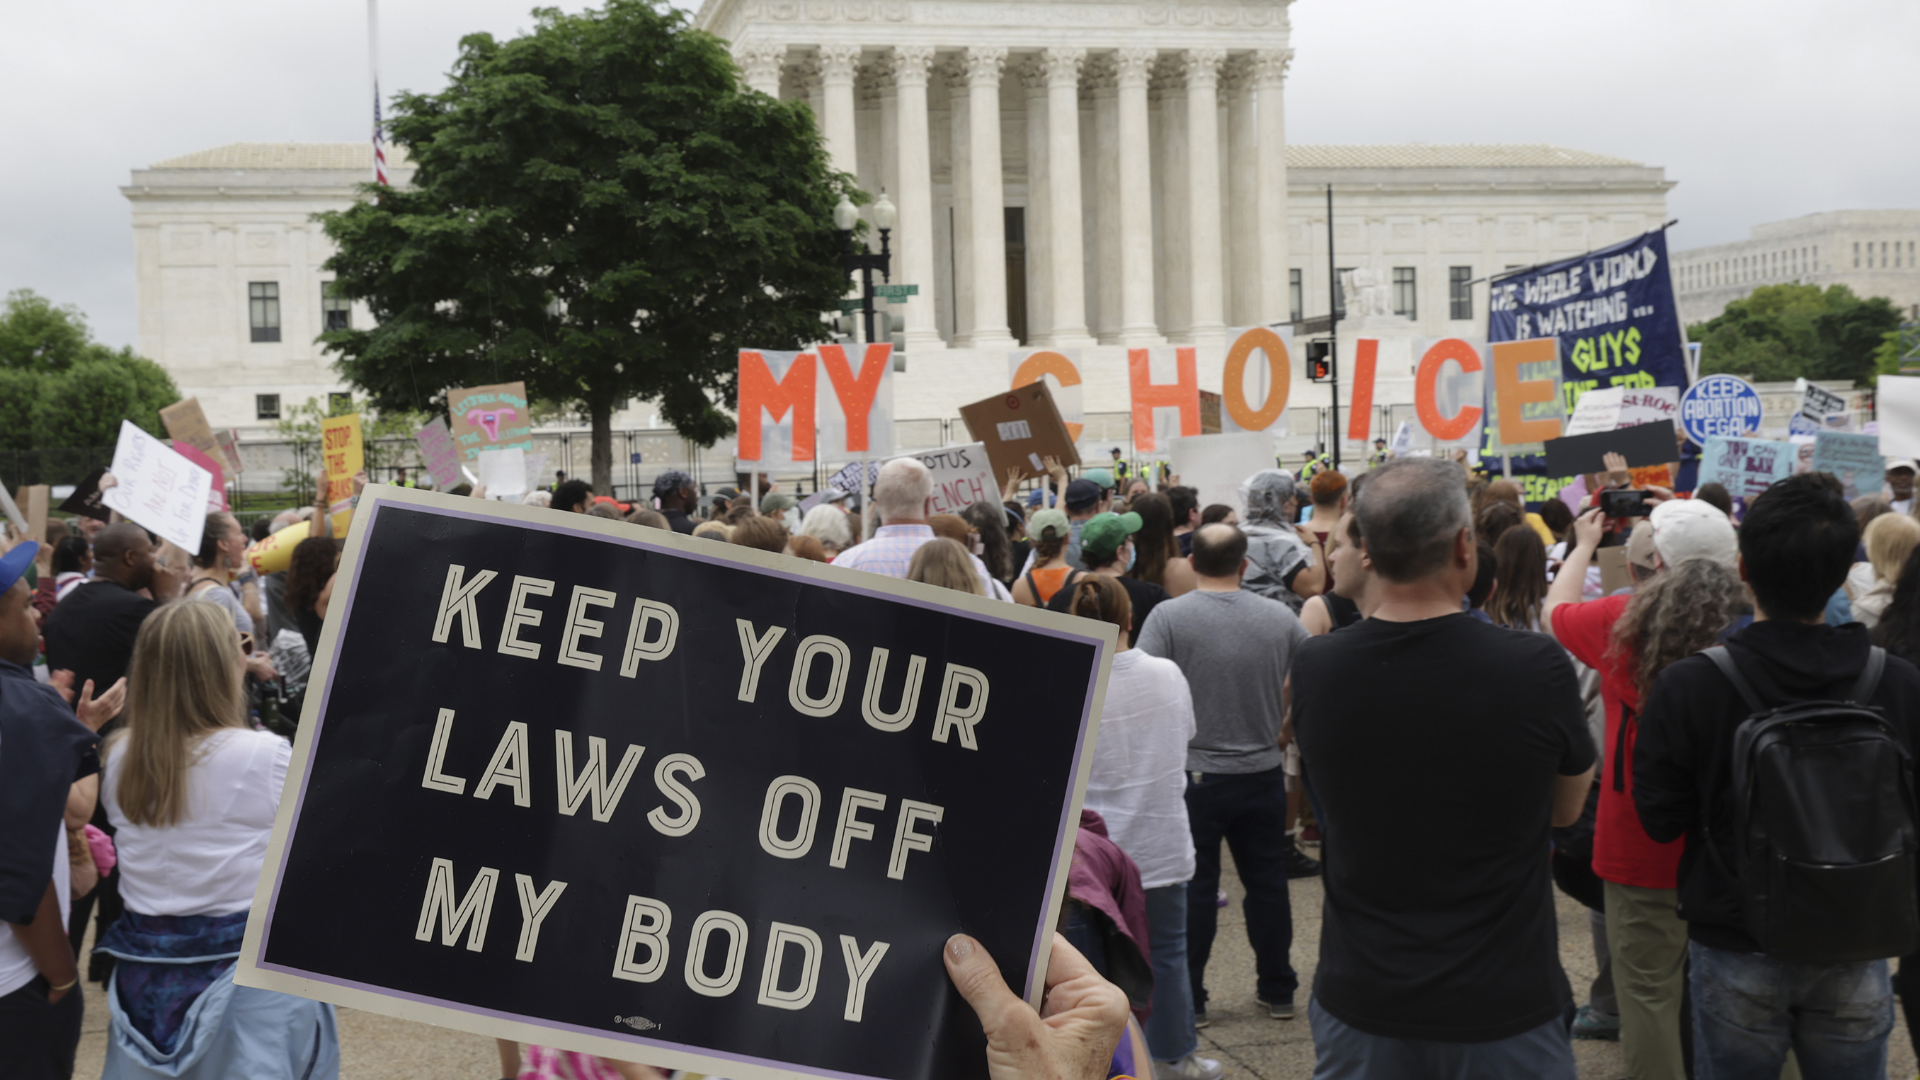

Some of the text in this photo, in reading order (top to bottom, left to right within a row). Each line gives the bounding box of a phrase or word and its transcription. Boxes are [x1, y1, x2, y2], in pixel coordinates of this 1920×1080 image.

[1524, 266, 1583, 305] WHOLE
[1589, 246, 1658, 293] WORLD
[1516, 313, 1531, 340] IS
[1537, 291, 1627, 336] WATCHING
[1571, 326, 1641, 373] GUYS
[738, 344, 892, 461] MY
[1684, 397, 1759, 420] ABORTION
[1696, 379, 1746, 398] KEEP
[1692, 417, 1753, 438] LEGAL
[327, 453, 348, 475] THE
[916, 449, 971, 469] OTUS
[1745, 456, 1775, 474] BAN
[932, 471, 987, 513] ENCH"
[432, 564, 990, 751] KEEP YOUR
[421, 707, 945, 881] LAWS OFF
[414, 857, 890, 1021] MY BODY
